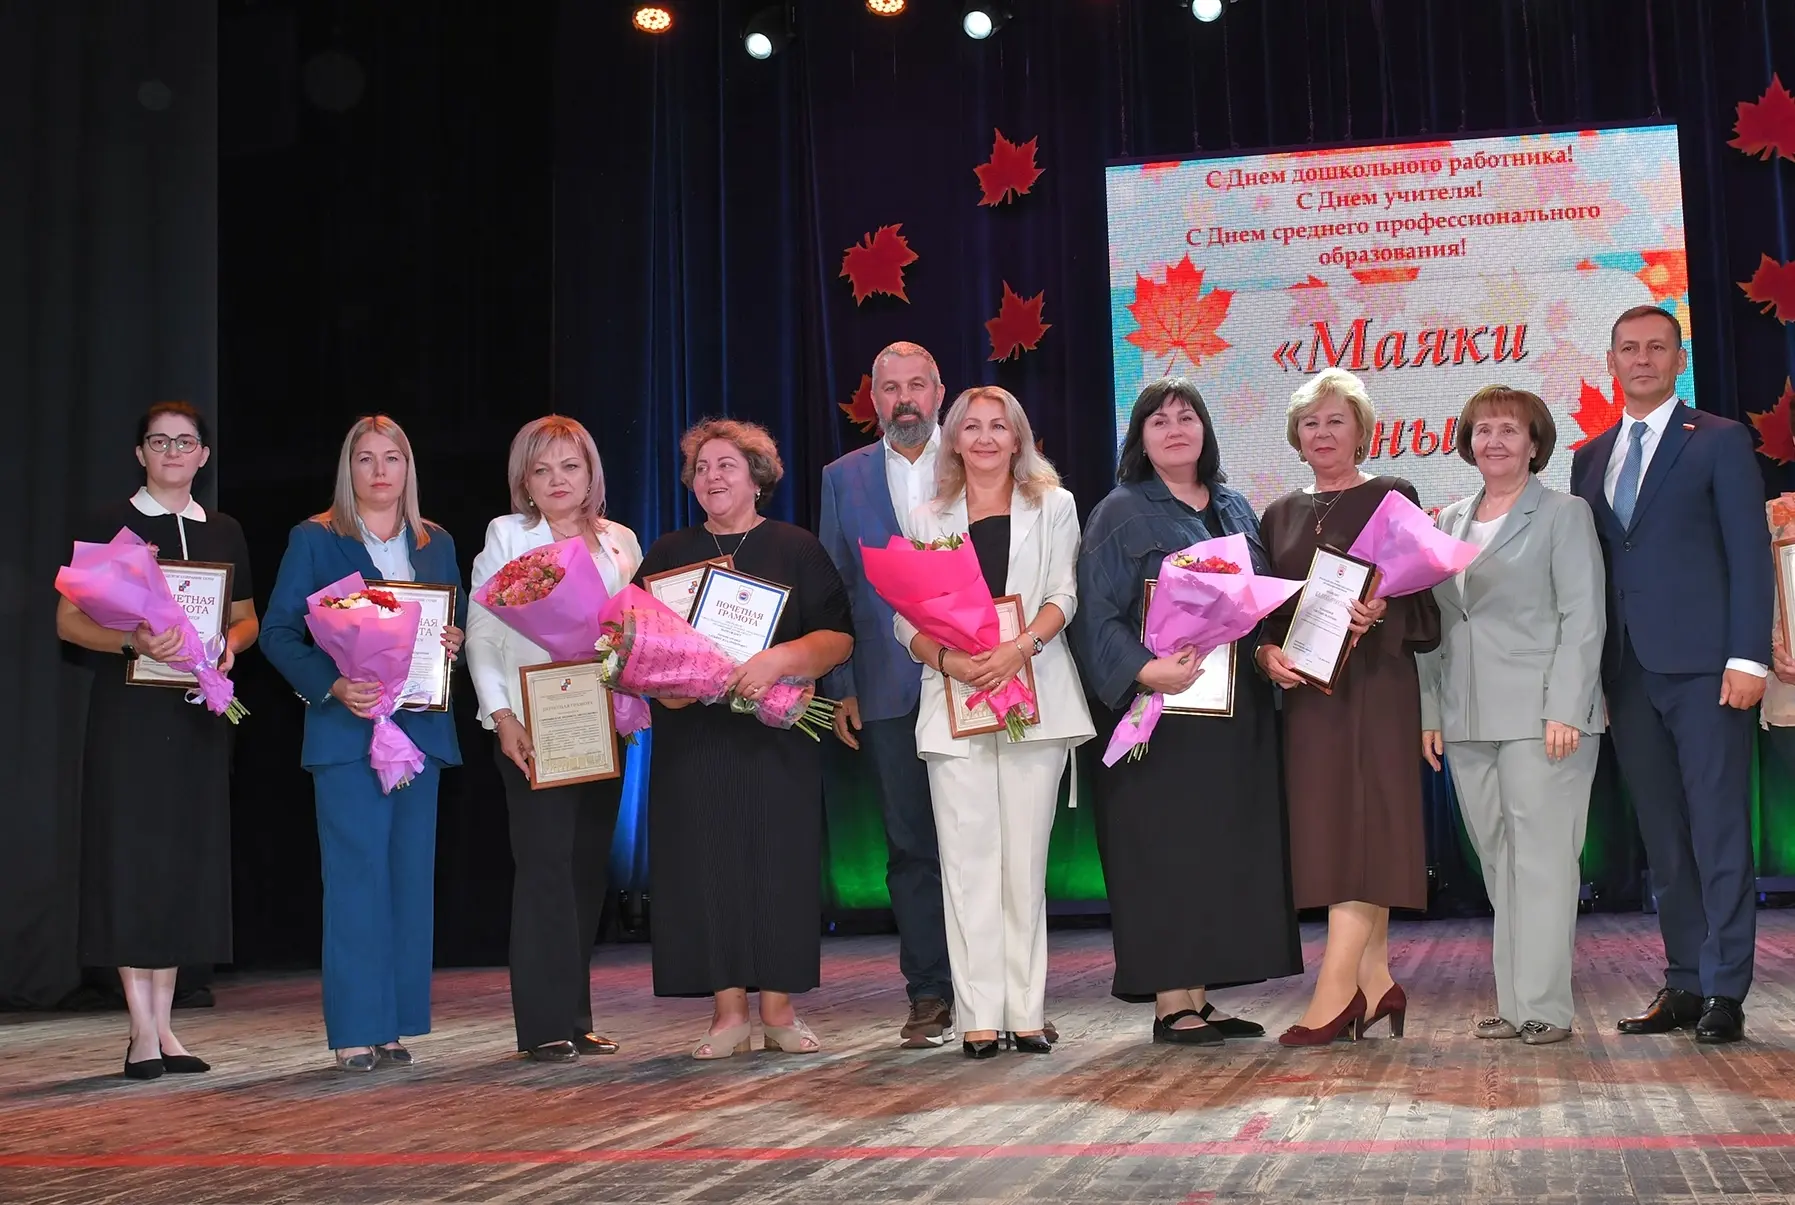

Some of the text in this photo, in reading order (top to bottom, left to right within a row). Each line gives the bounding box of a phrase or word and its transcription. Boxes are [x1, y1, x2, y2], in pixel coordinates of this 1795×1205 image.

[1206, 145, 1573, 190] С Днем дошкольного работника!
[1295, 180, 1483, 212] С Днем учителя!
[1186, 205, 1601, 248] С Днем среднего профессионального
[1318, 237, 1466, 270] образования!
[1271, 318, 1529, 375] «Маяки
[716, 599, 764, 621] ПОЧЕТНАЯ
[717, 608, 758, 627] ГРАМОТА
